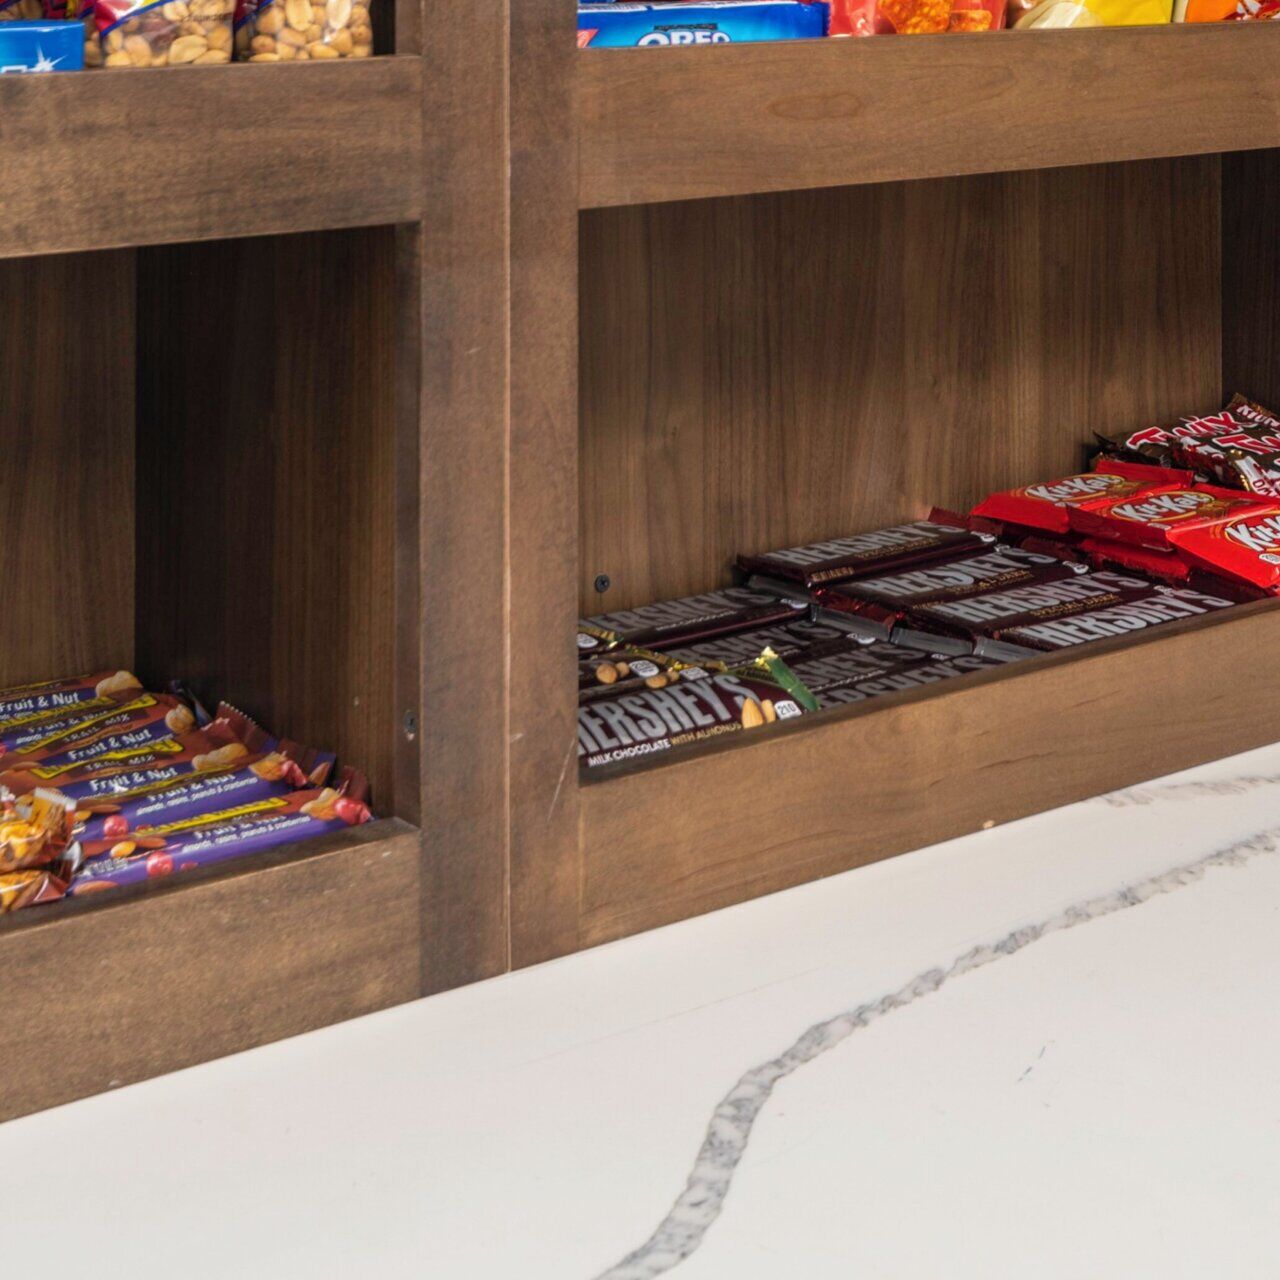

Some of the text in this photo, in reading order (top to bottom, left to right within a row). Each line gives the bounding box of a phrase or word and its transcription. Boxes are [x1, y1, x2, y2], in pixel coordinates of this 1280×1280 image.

[1127, 409, 1239, 451] TWIX
[1031, 473, 1127, 502] KitKat
[1110, 491, 1216, 524] KitKat
[763, 520, 970, 568] HERSHEY'S
[868, 546, 1058, 597] HERSHEY'S
[933, 570, 1152, 624] HERSHEY'S
[1006, 587, 1237, 649] HERSHEY'S
[37, 696, 49, 708] &
[52, 691, 81, 705] Nut
[777, 704, 797, 716] 210
[68, 728, 154, 762] Fruit & Nut
[588, 722, 743, 767] MILK CHOCOLATE WITH ALMONDS
[88, 765, 179, 793] Fruit & Nut
